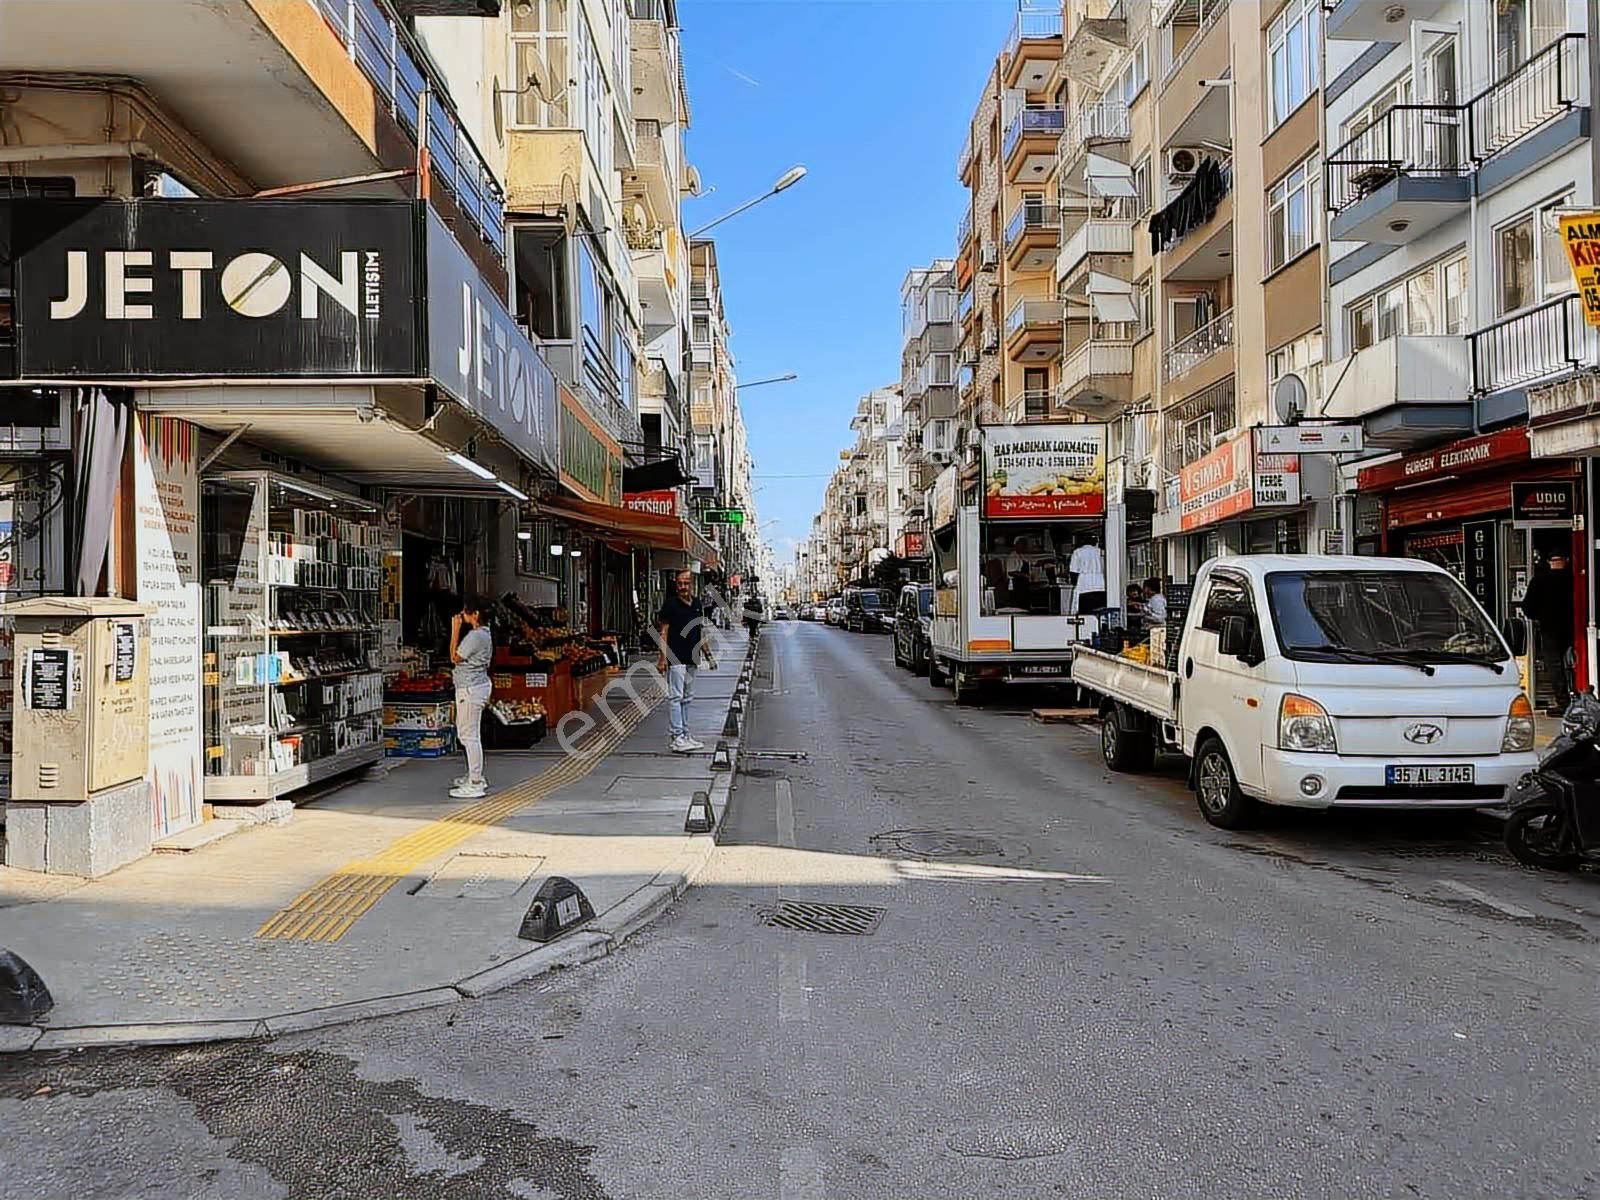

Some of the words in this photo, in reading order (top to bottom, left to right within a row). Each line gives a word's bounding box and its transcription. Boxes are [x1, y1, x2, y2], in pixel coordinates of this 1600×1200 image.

[50, 251, 359, 321] JETON
[458, 281, 541, 438] JETON
[1260, 475, 1283, 487] PERDE
[1257, 491, 1287, 503] TASARIM
[1394, 767, 1411, 782] 35
[1417, 767, 1434, 782] AL
[1439, 767, 1471, 782] 3145
